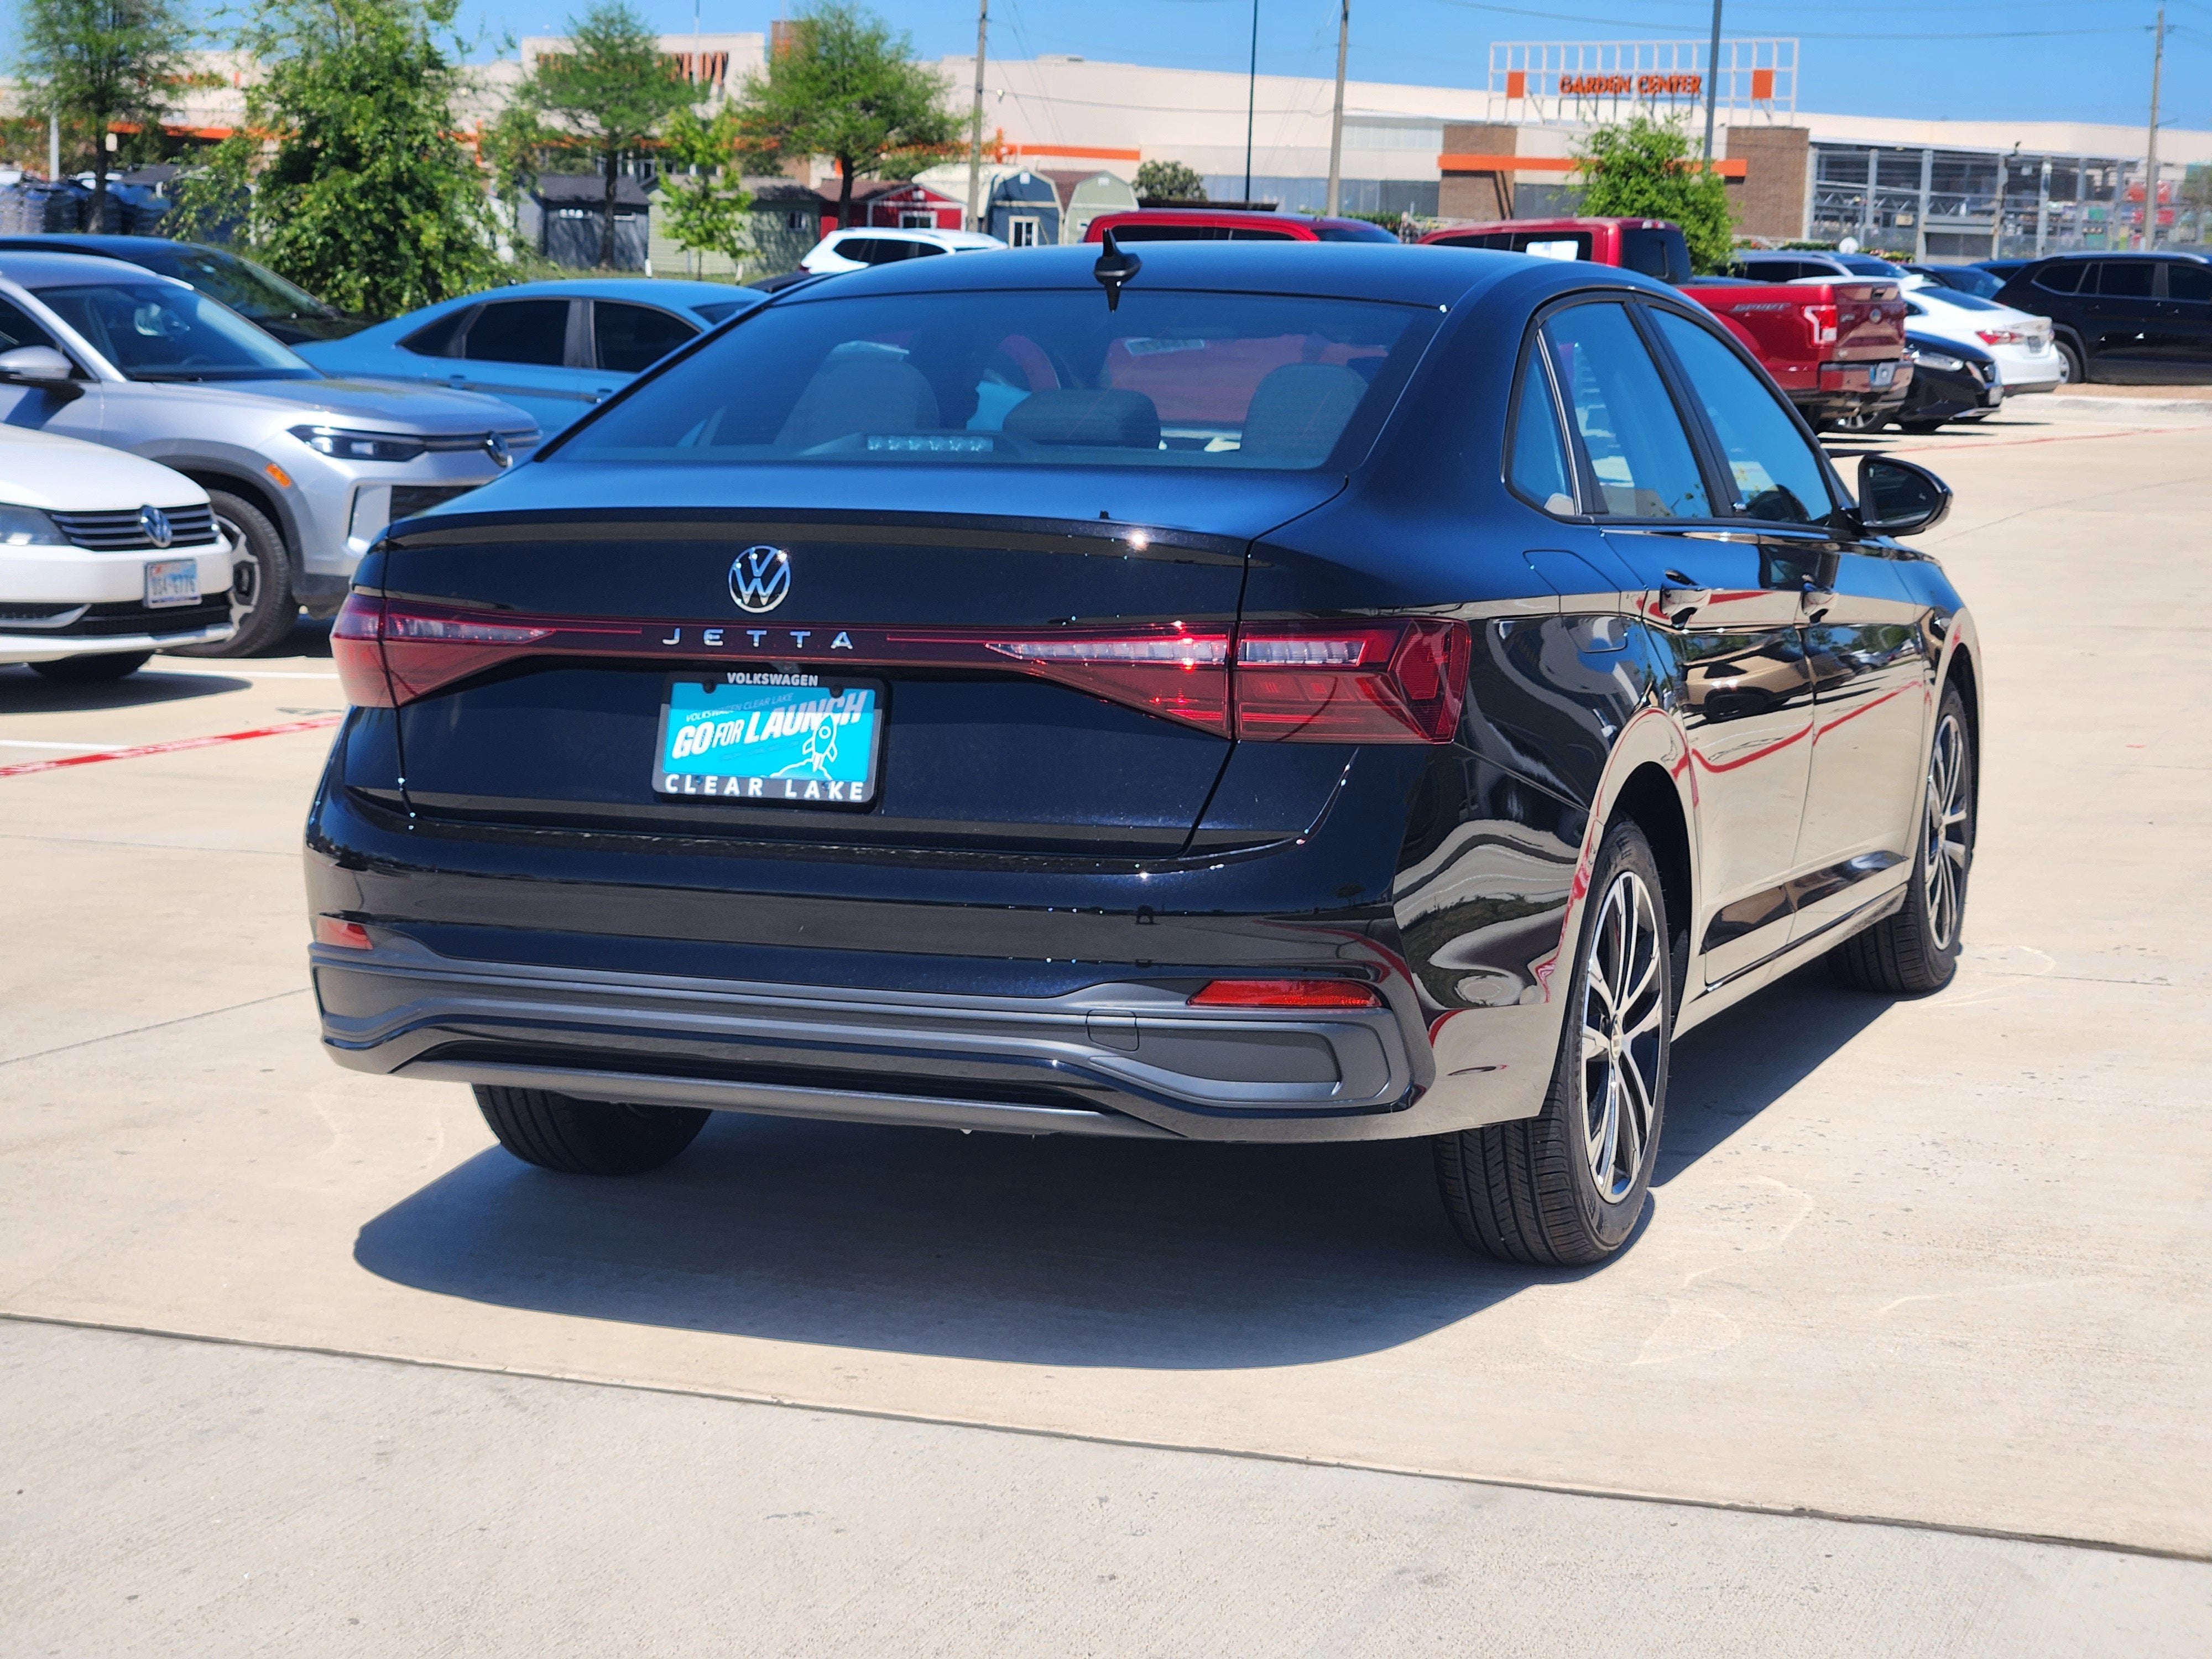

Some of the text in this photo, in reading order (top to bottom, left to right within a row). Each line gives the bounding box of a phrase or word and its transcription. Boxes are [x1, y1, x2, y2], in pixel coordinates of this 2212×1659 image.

[1559, 75, 1702, 95] GARDEN CENTER
[662, 628, 853, 649] JETTA
[727, 672, 818, 686] VOLKSWAGEN
[743, 697, 771, 711] CLEAR
[771, 692, 795, 705] LAKE
[672, 721, 716, 759] GO
[711, 718, 745, 748] FOR
[744, 690, 868, 744] LAUNCH
[665, 774, 864, 801] CLEAR LAKE
